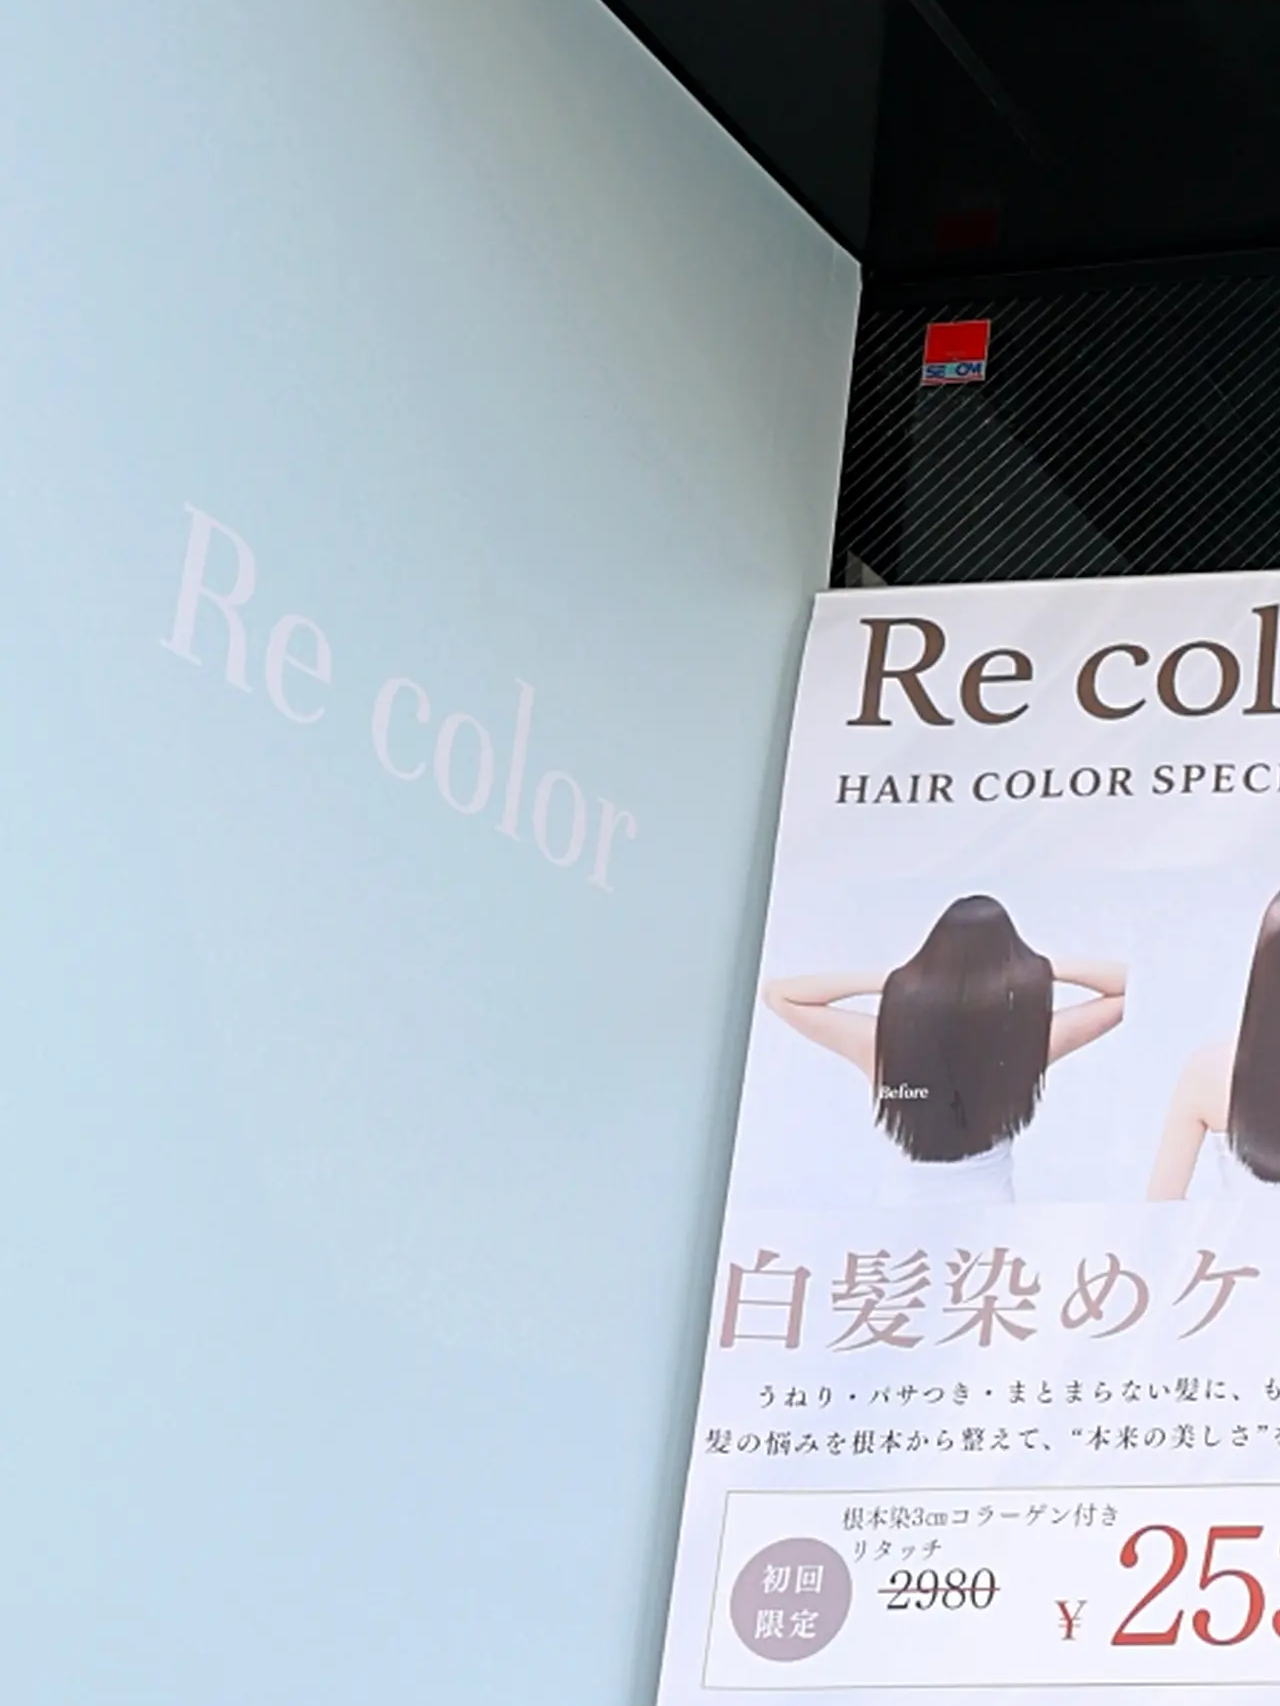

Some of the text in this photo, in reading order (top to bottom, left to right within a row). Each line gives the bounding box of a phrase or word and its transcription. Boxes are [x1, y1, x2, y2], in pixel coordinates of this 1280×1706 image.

[926, 362, 982, 377] SEOM
[847, 616, 1033, 729] Re
[159, 502, 639, 893] Re color
[835, 774, 954, 804] HAIR
[973, 767, 1136, 802] COLOR
[879, 1083, 929, 1099] Before
[853, 1539, 942, 1563] リタッチ
[761, 1562, 823, 1595] 初回
[885, 1567, 998, 1611] 2980
[755, 1609, 818, 1640] 限定
